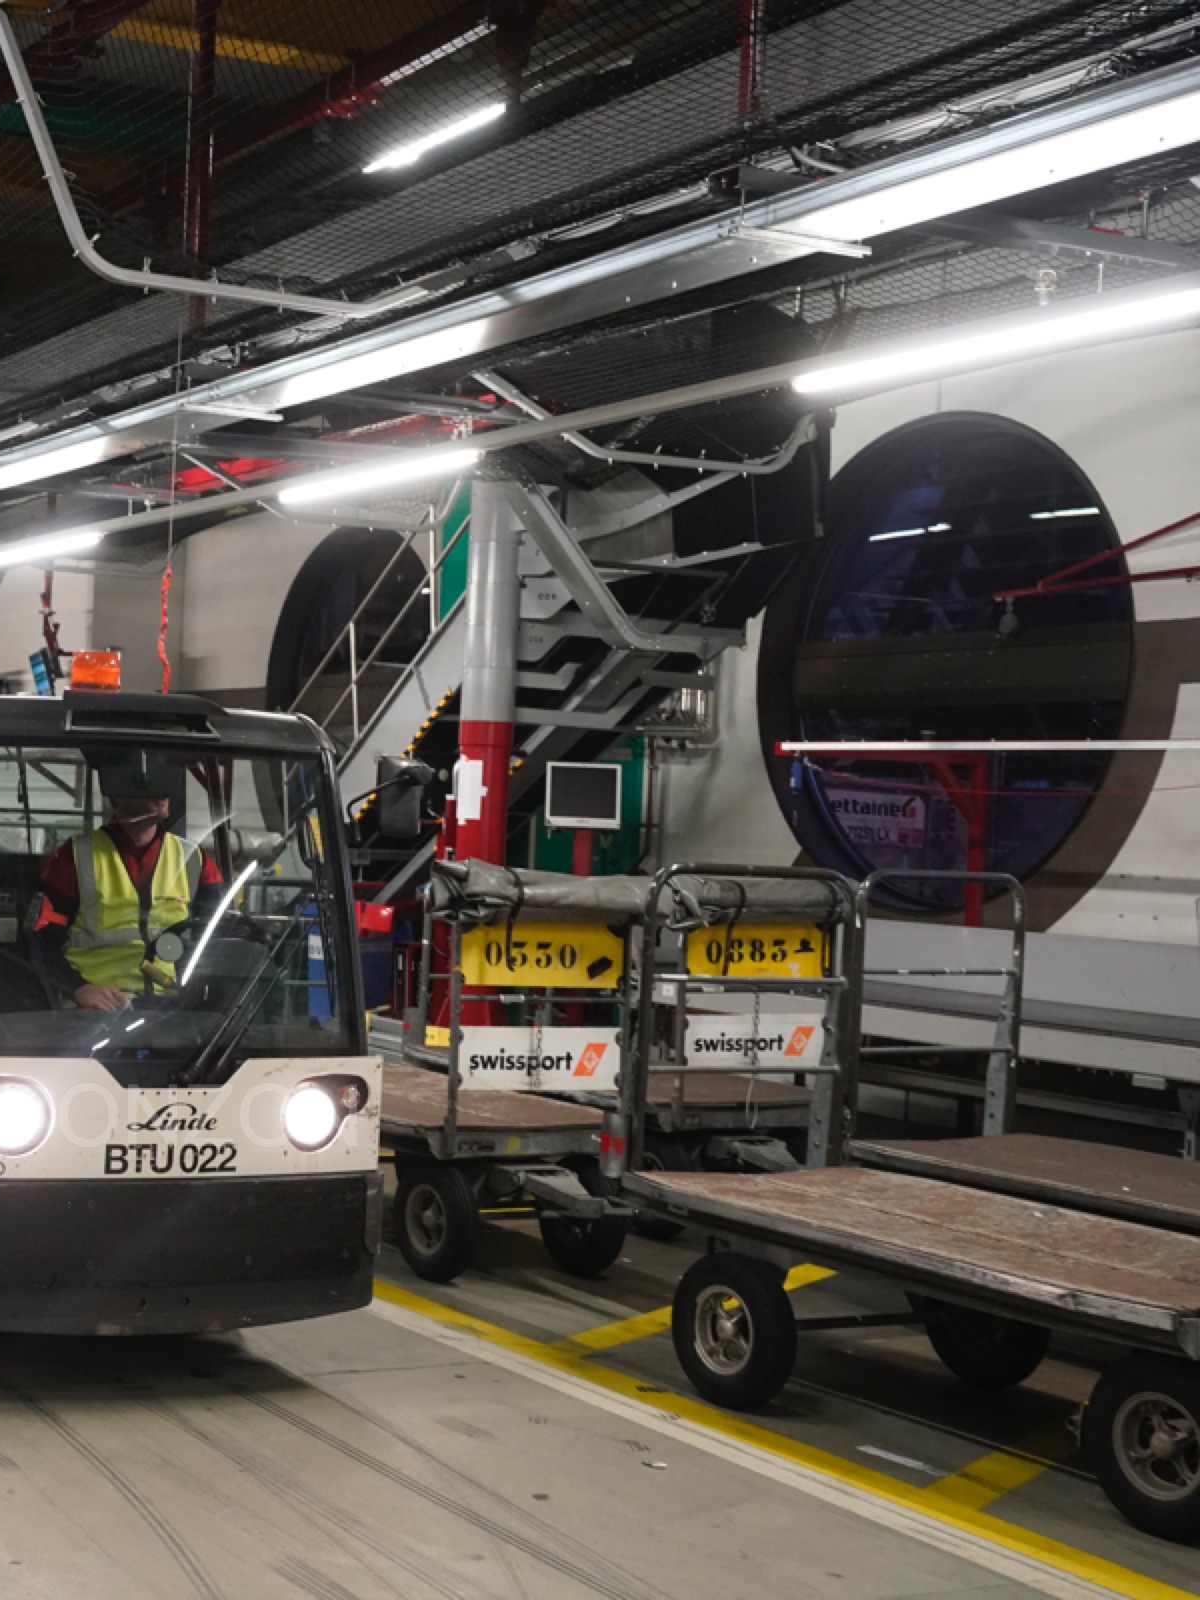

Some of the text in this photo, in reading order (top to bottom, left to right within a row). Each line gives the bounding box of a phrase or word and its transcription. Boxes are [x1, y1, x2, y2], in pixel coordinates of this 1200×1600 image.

[830, 797, 917, 818] ettainer
[694, 1031, 785, 1057] swissport
[469, 1047, 573, 1076] swissport
[126, 1101, 218, 1132] Linde
[103, 1142, 238, 1176] BTU 022
